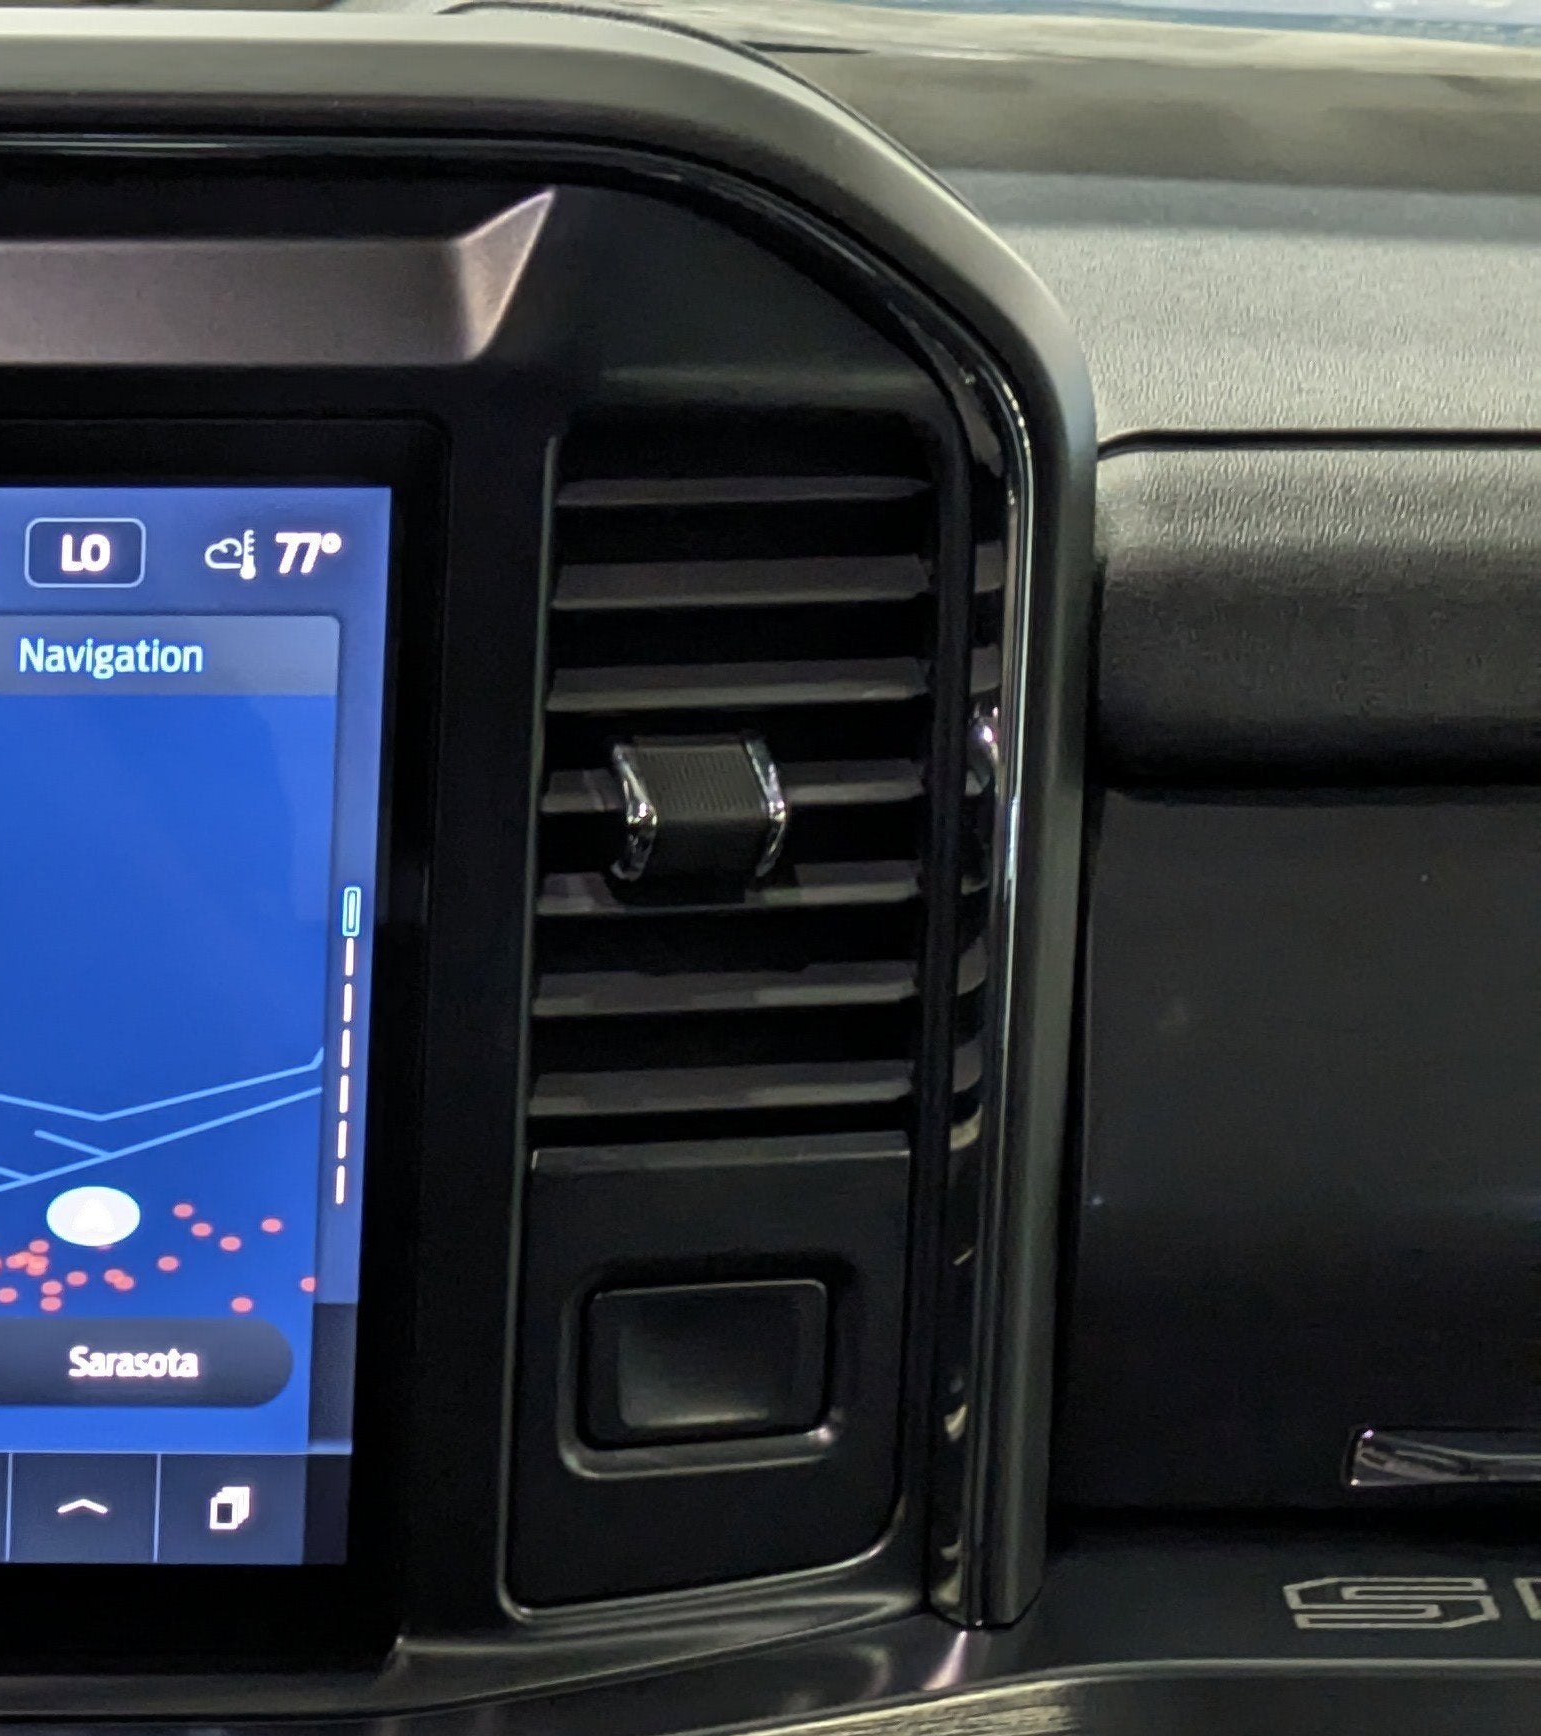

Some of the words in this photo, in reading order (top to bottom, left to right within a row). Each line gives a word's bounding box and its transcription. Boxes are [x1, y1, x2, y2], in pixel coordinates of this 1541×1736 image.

[61, 533, 111, 572] LO
[275, 532, 342, 574] 77°
[19, 638, 203, 679] Navigation
[68, 1345, 199, 1378] Sarasota
